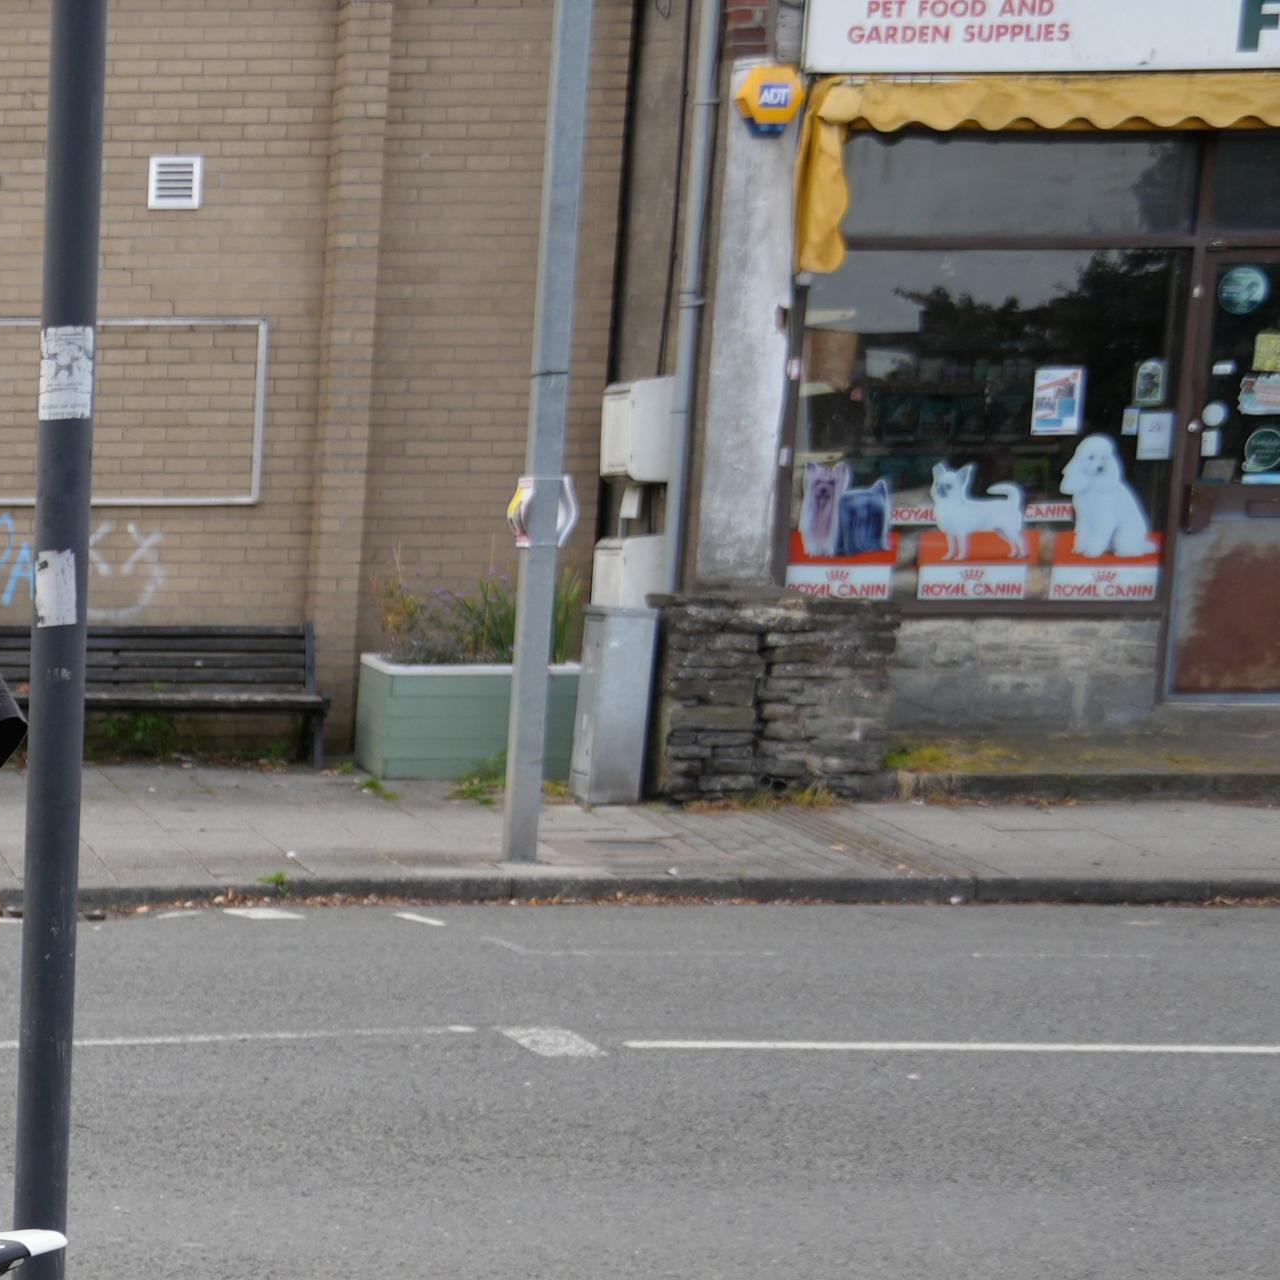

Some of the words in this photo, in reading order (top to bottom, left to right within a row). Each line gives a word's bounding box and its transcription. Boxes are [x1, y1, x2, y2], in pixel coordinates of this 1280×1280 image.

[866, 0, 906, 18] PET
[918, 0, 986, 18] FOOD
[998, 0, 1055, 17] AND
[848, 26, 950, 44] GARDEN
[963, 23, 1070, 43] SUPPLIES
[759, 87, 790, 105] ADT
[838, 583, 886, 597] CANIN
[921, 584, 967, 597] ROYAL
[974, 583, 1022, 597] CANIN
[1053, 584, 1100, 597] ROYAL
[1104, 583, 1153, 597] CANIN
